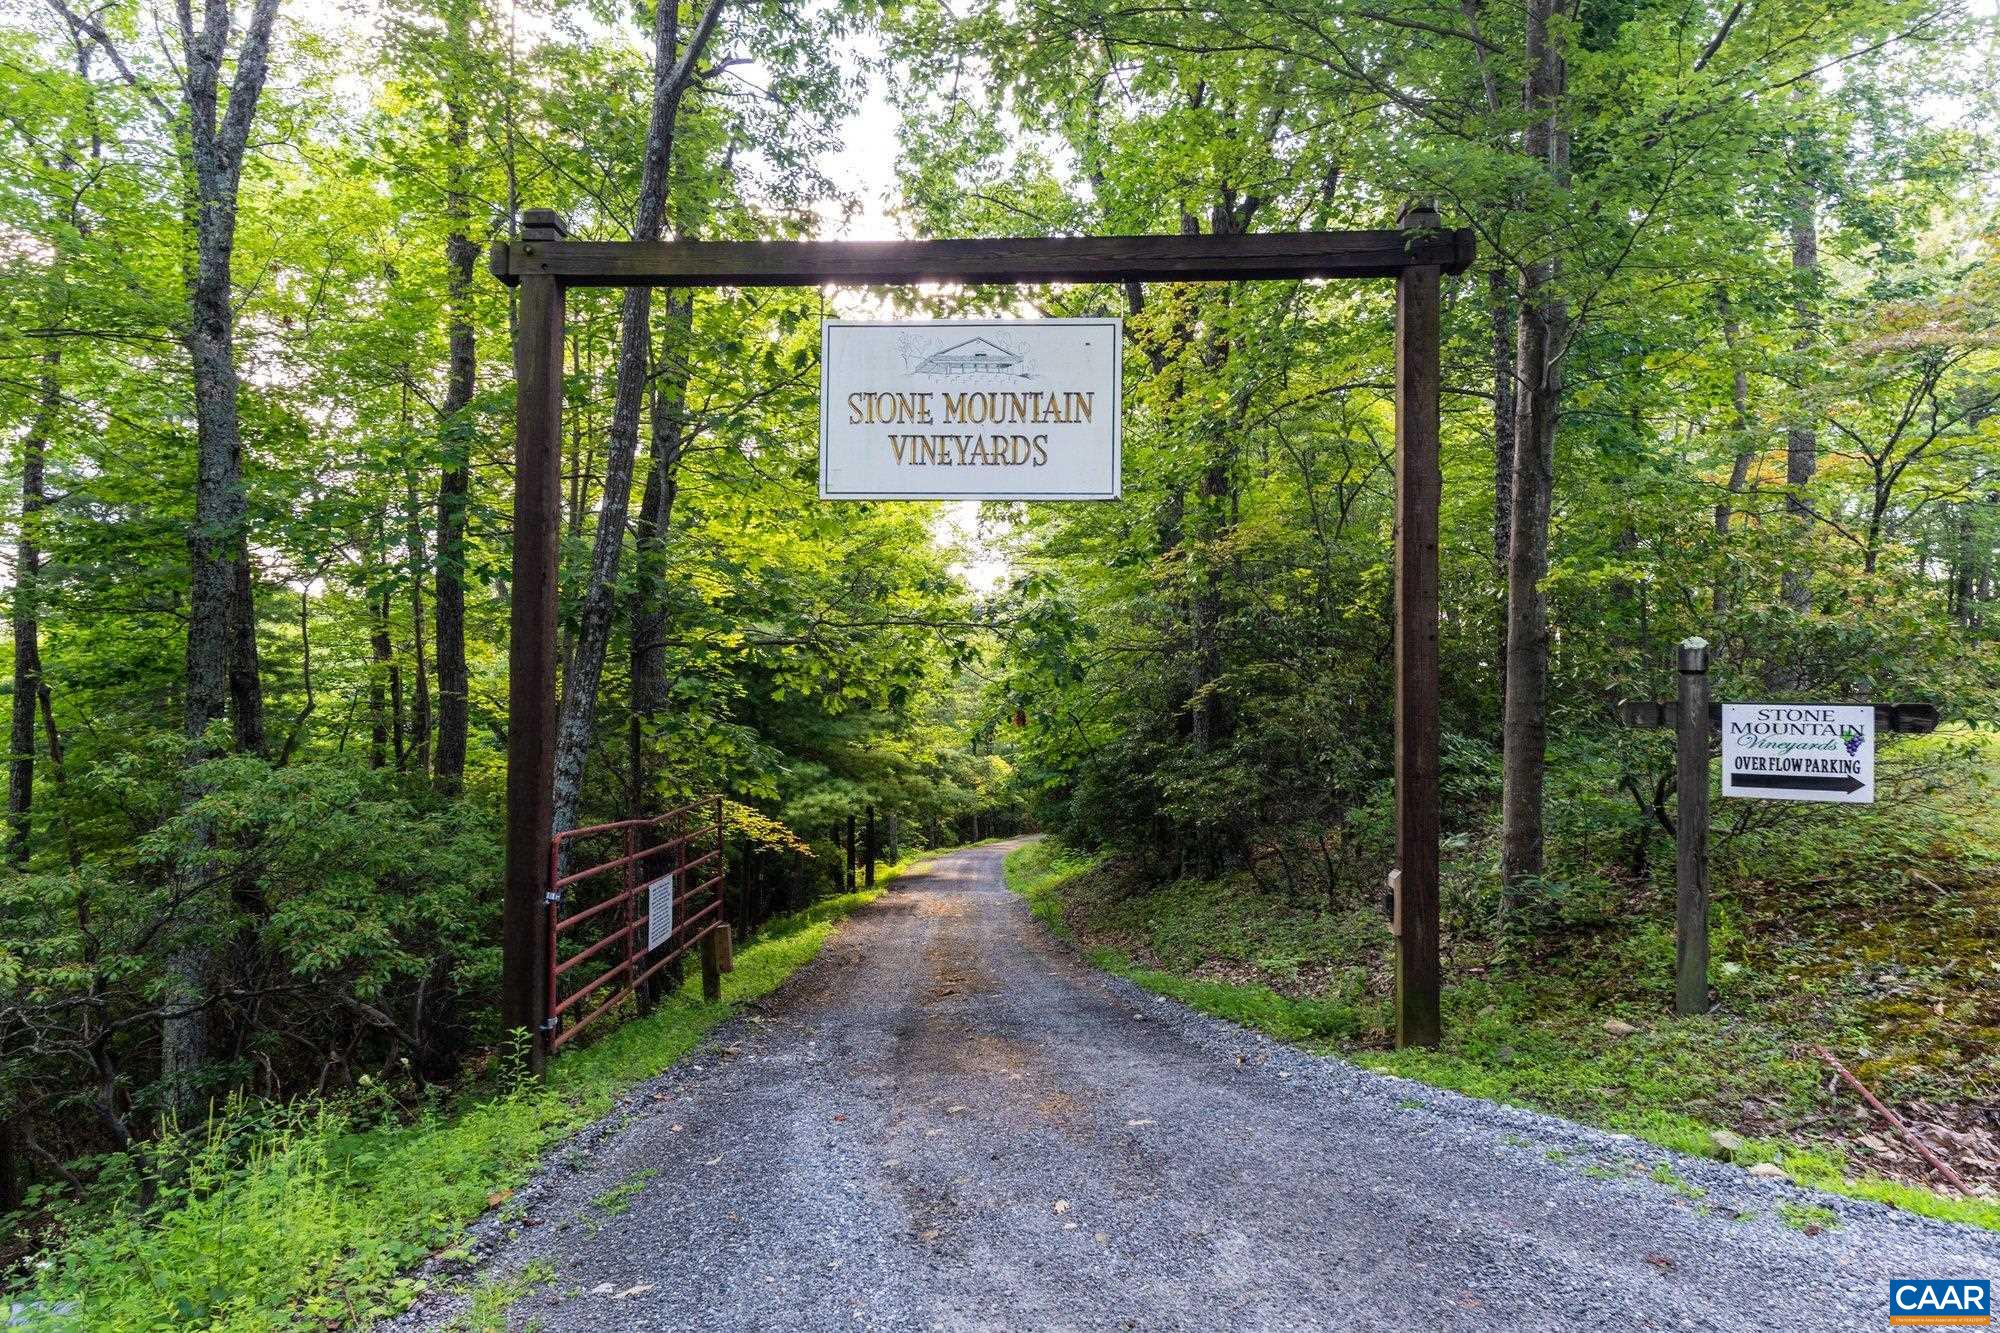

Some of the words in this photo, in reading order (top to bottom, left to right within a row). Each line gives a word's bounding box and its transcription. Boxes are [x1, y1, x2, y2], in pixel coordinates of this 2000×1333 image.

[847, 391, 934, 425] STONE
[942, 391, 1095, 425] MOUNTAIN
[888, 434, 1048, 467] VINEYARDS
[1757, 709, 1835, 722] STONE
[1730, 722, 1865, 737] MOUNTAIN
[1737, 732, 1839, 756] Vineyards
[1804, 759, 1862, 774] PARKING
